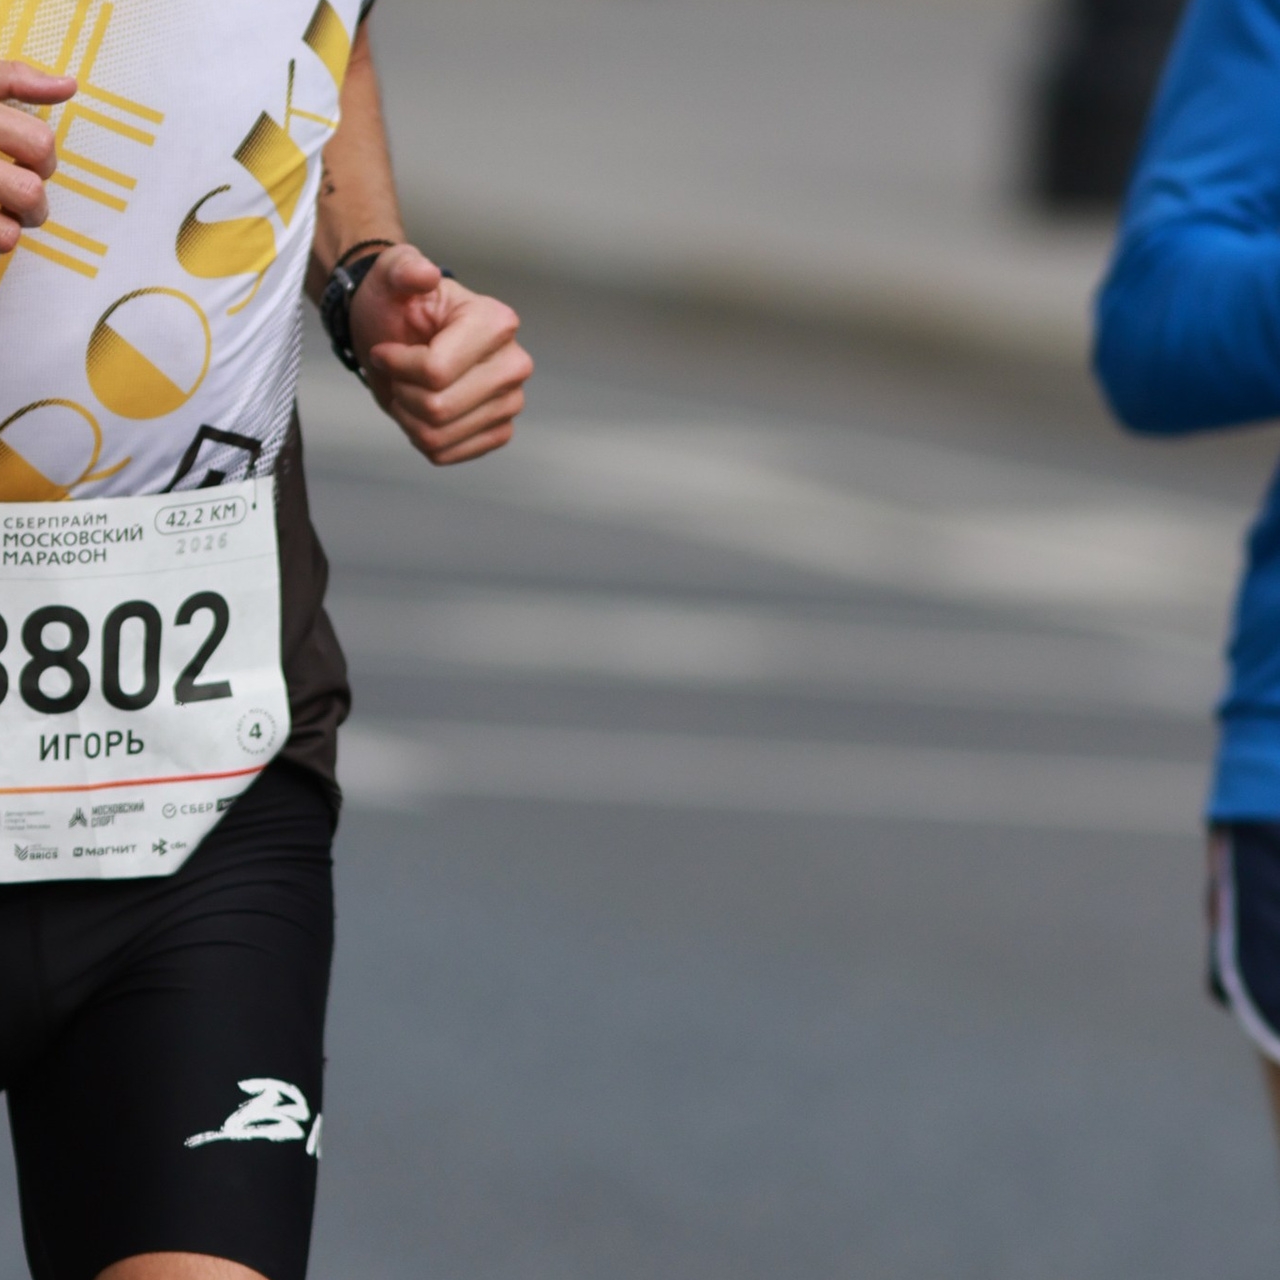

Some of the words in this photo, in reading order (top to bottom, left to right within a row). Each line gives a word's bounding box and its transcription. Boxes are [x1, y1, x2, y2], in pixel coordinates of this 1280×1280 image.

[3, 512, 108, 529] СБЕРПРАЙМ
[165, 508, 204, 528] 42,2
[210, 503, 237, 522] КМ
[3, 523, 144, 548] МОСКОВСКИЙ
[175, 532, 229, 555] 2026
[2, 548, 108, 566] МАРАФОН
[249, 722, 262, 739] 4
[39, 730, 145, 762] ИГОРЬ
[180, 803, 214, 815] СБЕР
